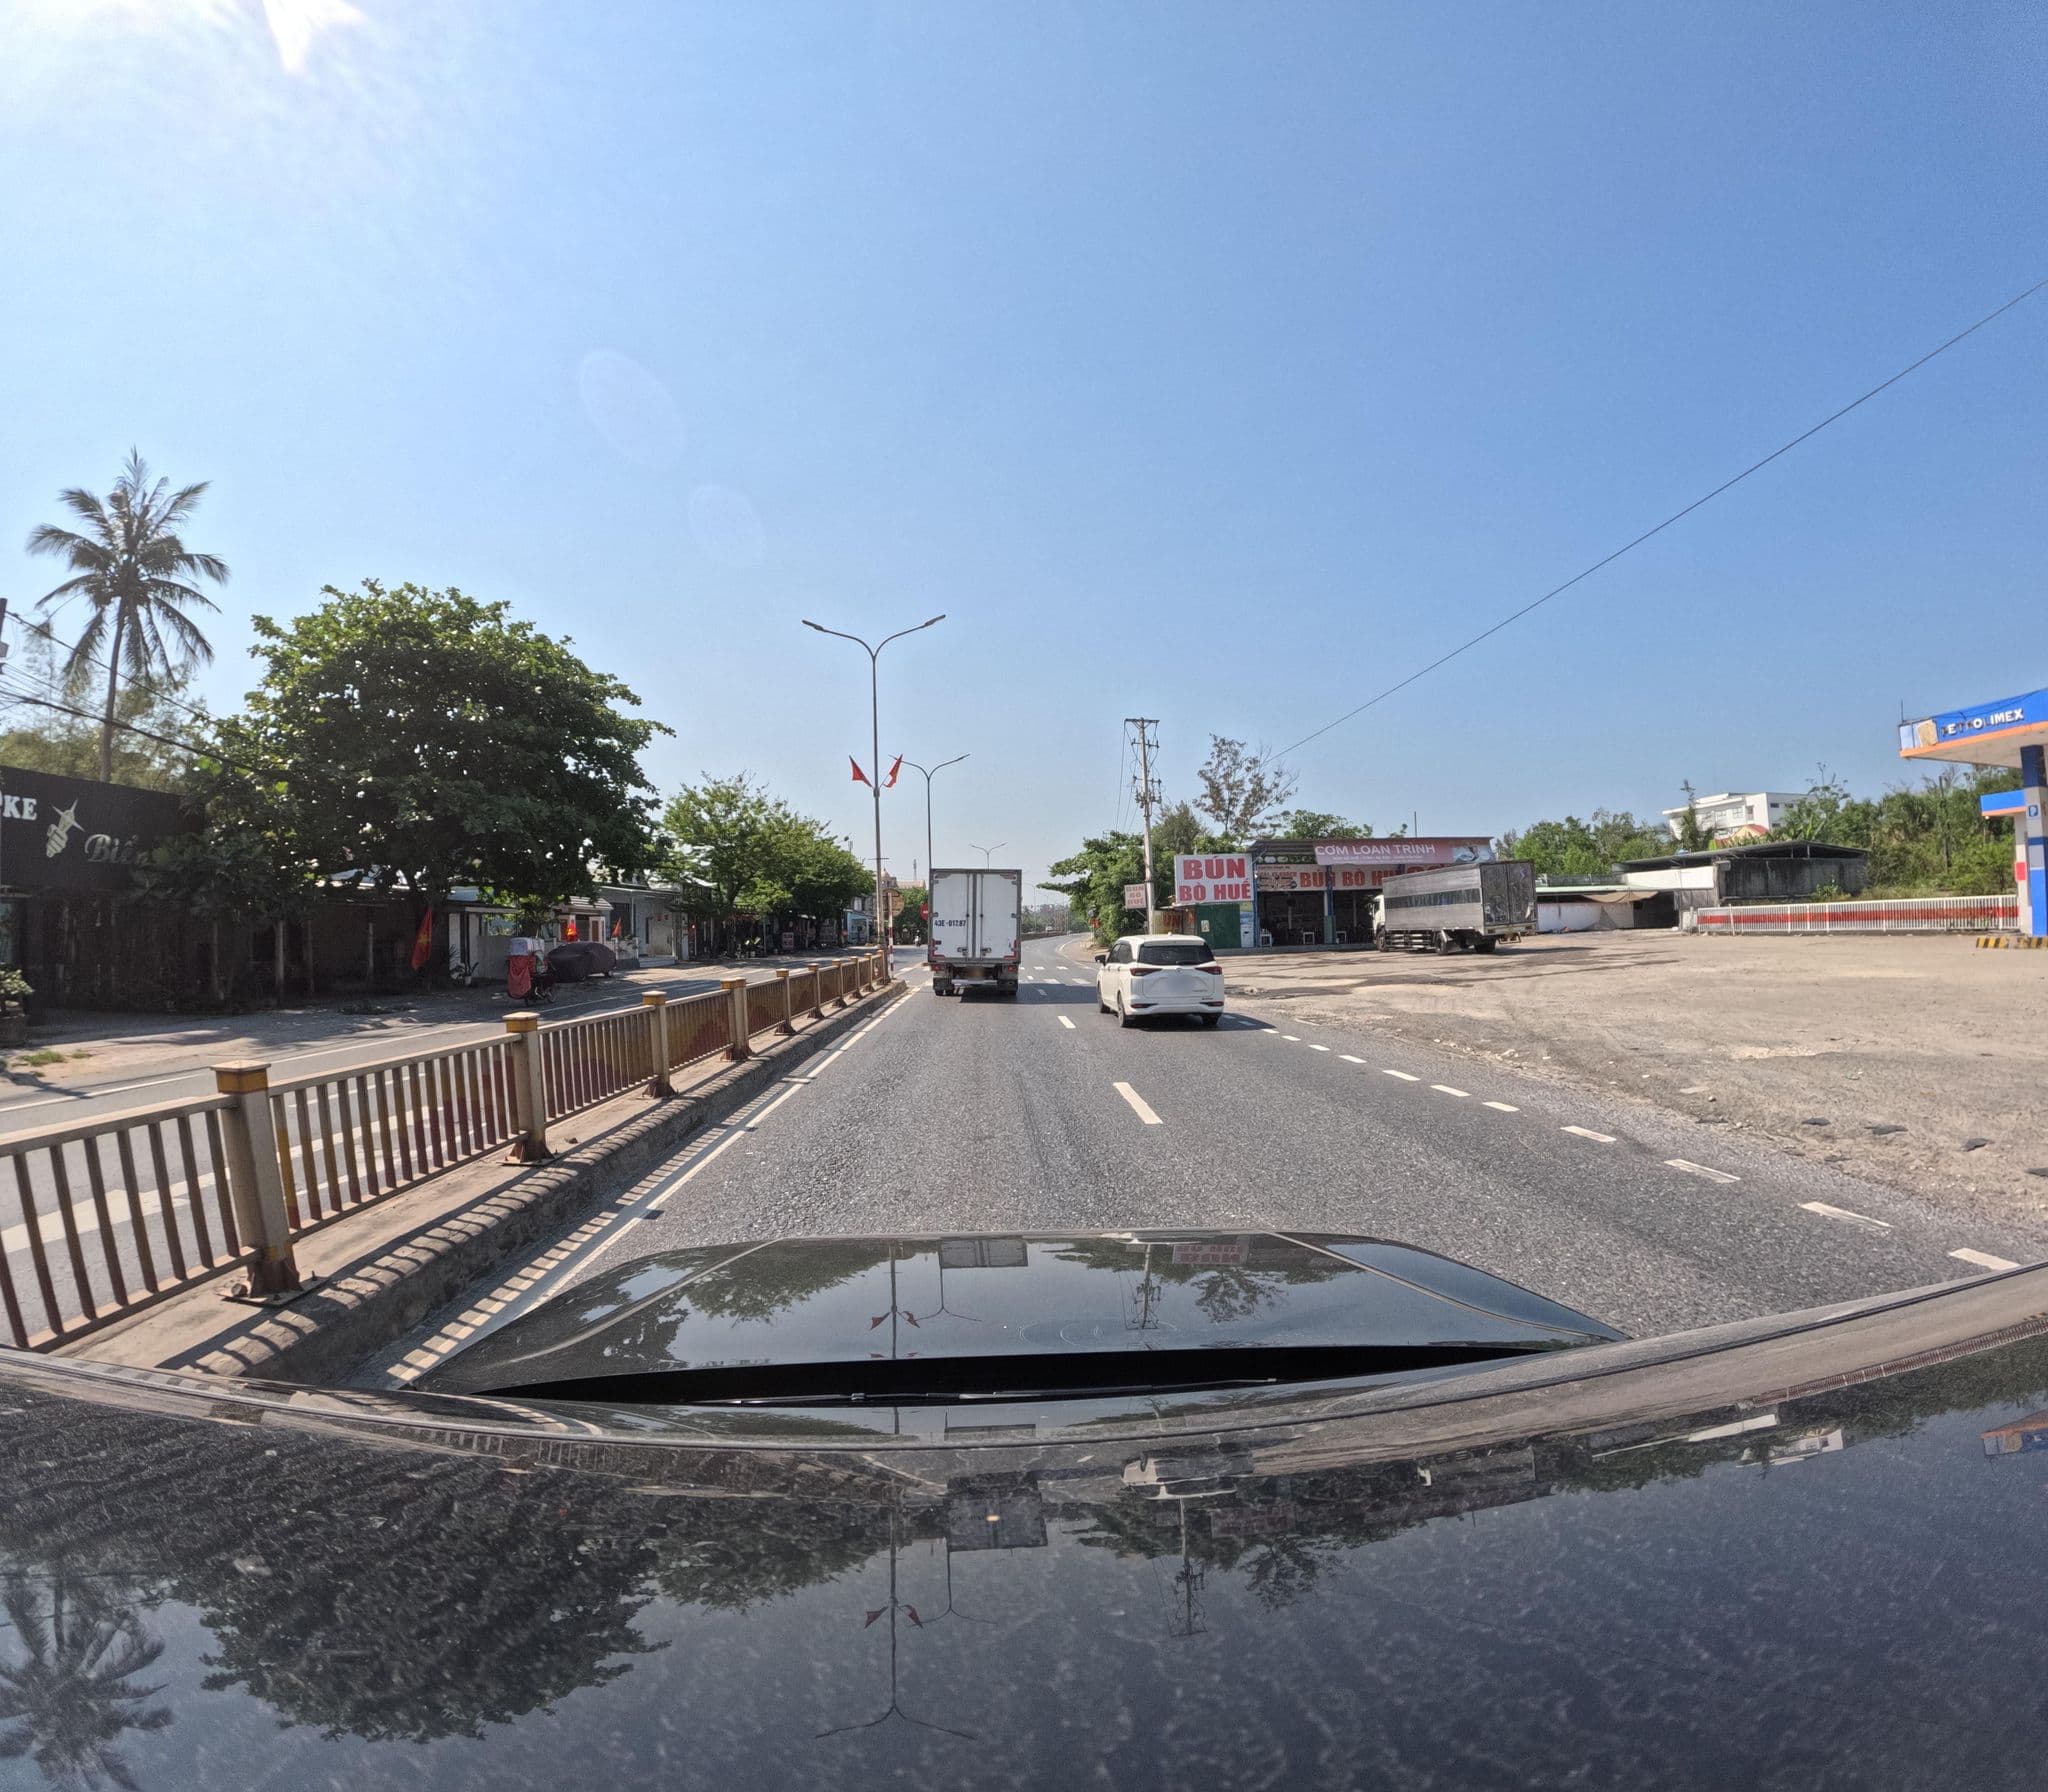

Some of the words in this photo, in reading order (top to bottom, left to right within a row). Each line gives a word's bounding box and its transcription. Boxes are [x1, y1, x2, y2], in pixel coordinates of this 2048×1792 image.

[1352, 844, 1391, 855] LOAN
[1183, 856, 1246, 880] BÚN
[1178, 881, 1206, 902] BÒ
[1213, 878, 1252, 900] HUẾ
